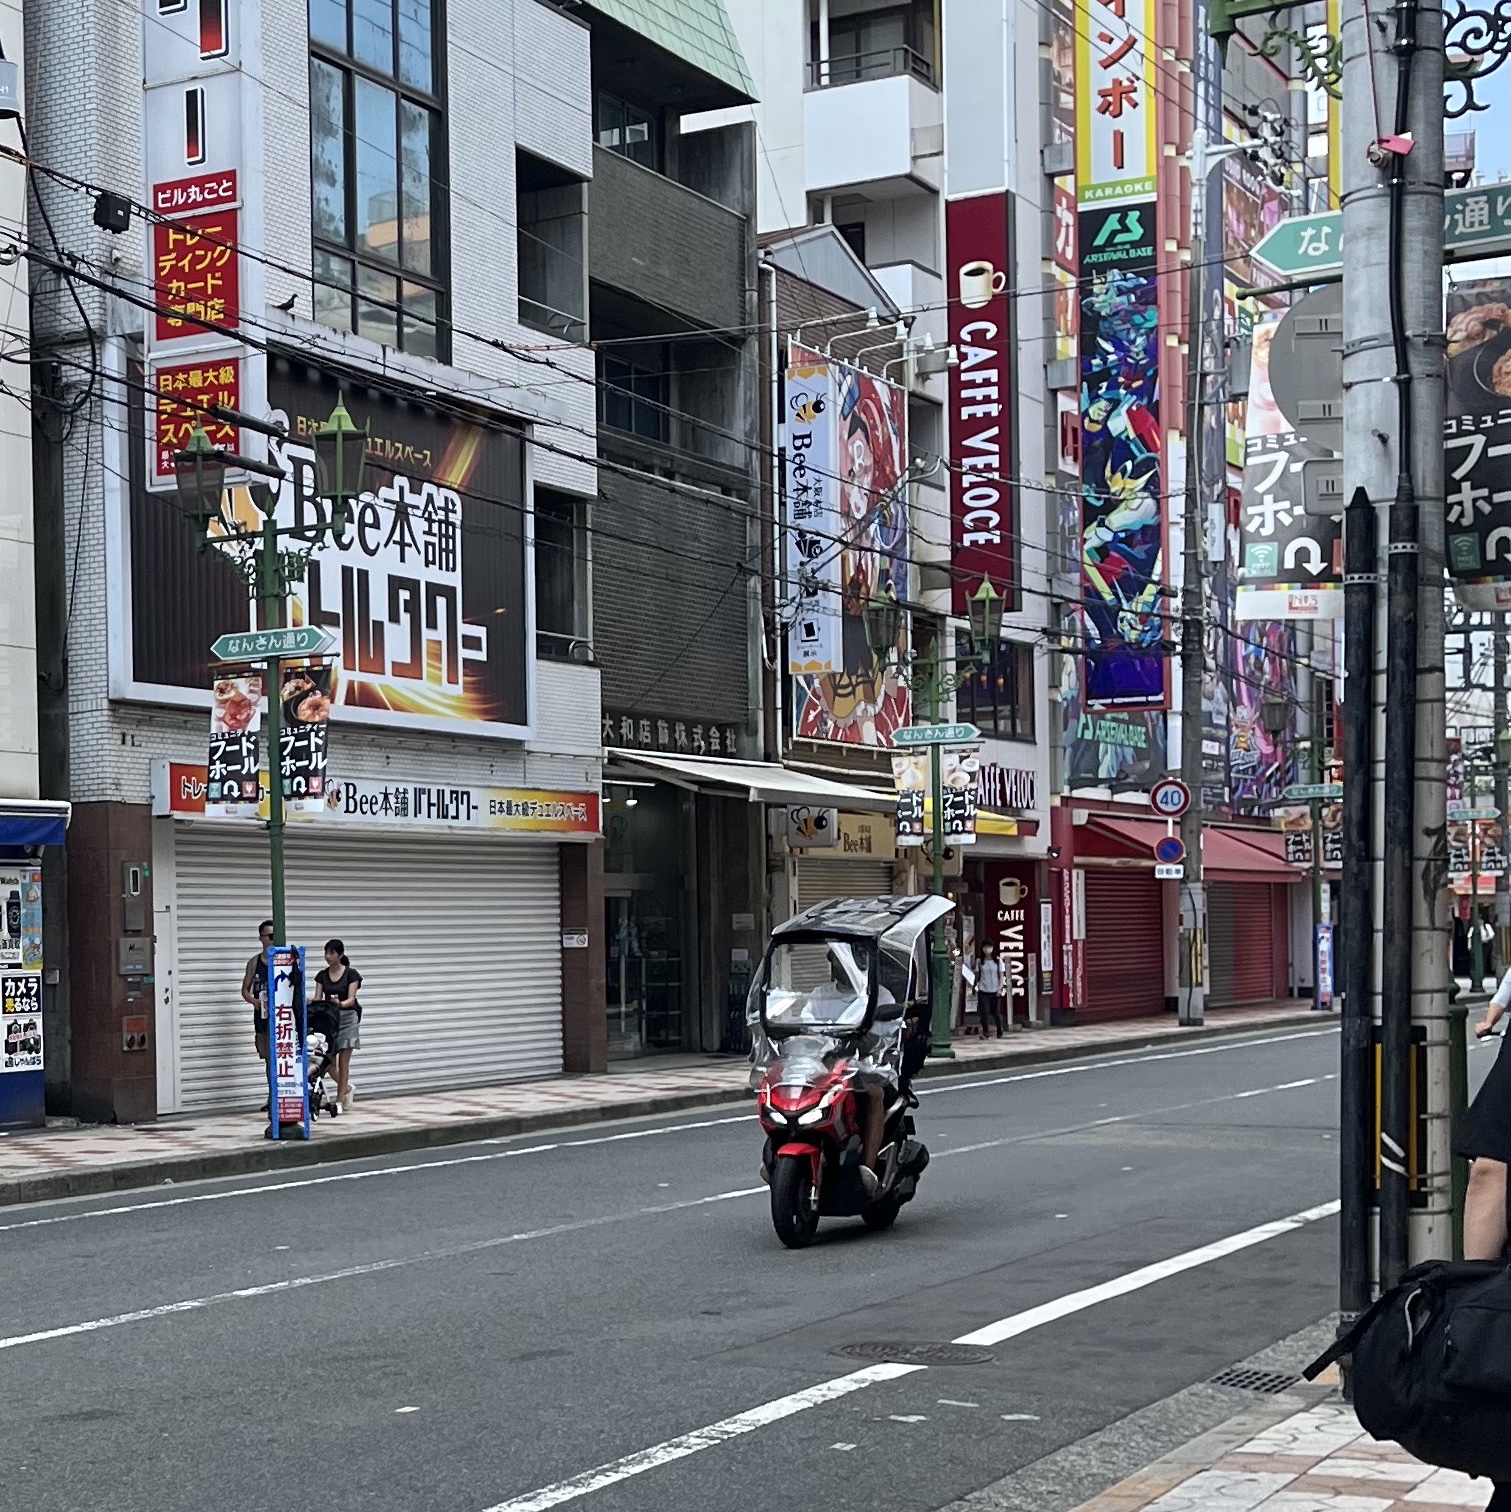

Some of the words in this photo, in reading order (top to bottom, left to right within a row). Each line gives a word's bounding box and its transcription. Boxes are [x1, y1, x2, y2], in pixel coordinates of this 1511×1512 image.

[157, 179, 233, 208] ビル丸ごと
[1085, 181, 1153, 199] KARAOKE
[169, 225, 222, 249] トレー
[158, 241, 233, 276] ディング
[168, 272, 223, 300] カード
[167, 298, 225, 327] 専門店
[159, 366, 235, 392] 日本最大級
[159, 390, 235, 420] デュエル
[793, 431, 813, 521] Bee本舗
[961, 426, 1001, 546] VELOCE
[228, 631, 308, 652] なんさん通り
[210, 735, 255, 760] フード
[280, 731, 325, 755] フード
[209, 757, 259, 780] ホール
[280, 751, 327, 776] ホール
[343, 782, 410, 818] Bee本舗
[413, 786, 480, 822] バトルタワー
[489, 798, 587, 823] 日本最大級デュエルスペース
[898, 790, 923, 806] ード
[943, 790, 976, 807] フード
[1159, 790, 1182, 807] 40
[943, 804, 977, 821] ホール
[4, 978, 38, 997] カメラ
[4, 997, 38, 1012] 売るなら
[275, 1004, 295, 1078] 右折禁止
